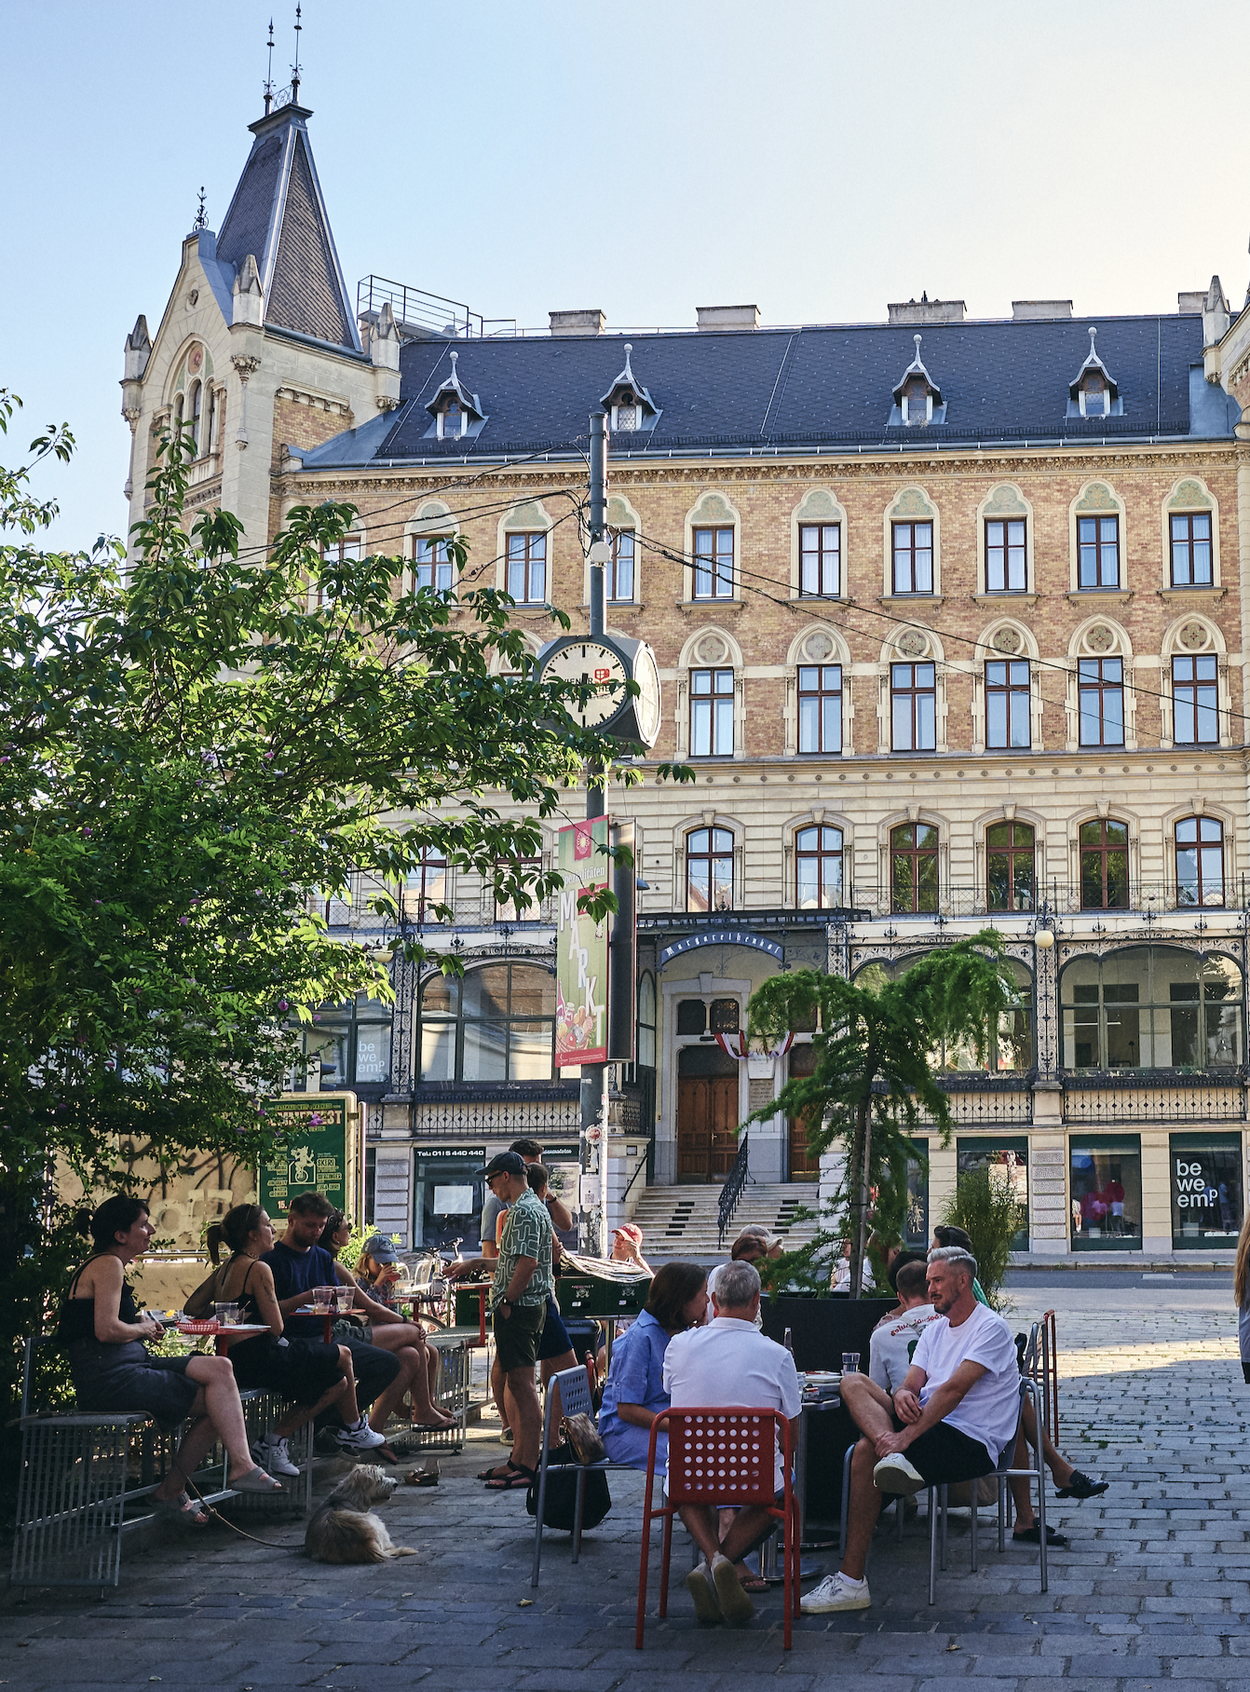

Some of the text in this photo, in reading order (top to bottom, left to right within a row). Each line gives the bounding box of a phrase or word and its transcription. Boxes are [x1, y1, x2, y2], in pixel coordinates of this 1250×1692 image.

[560, 889, 605, 1047] MARKT
[359, 1041, 376, 1053] be
[358, 1053, 377, 1063] we
[1176, 1158, 1202, 1177] be
[1176, 1178, 1206, 1192] we
